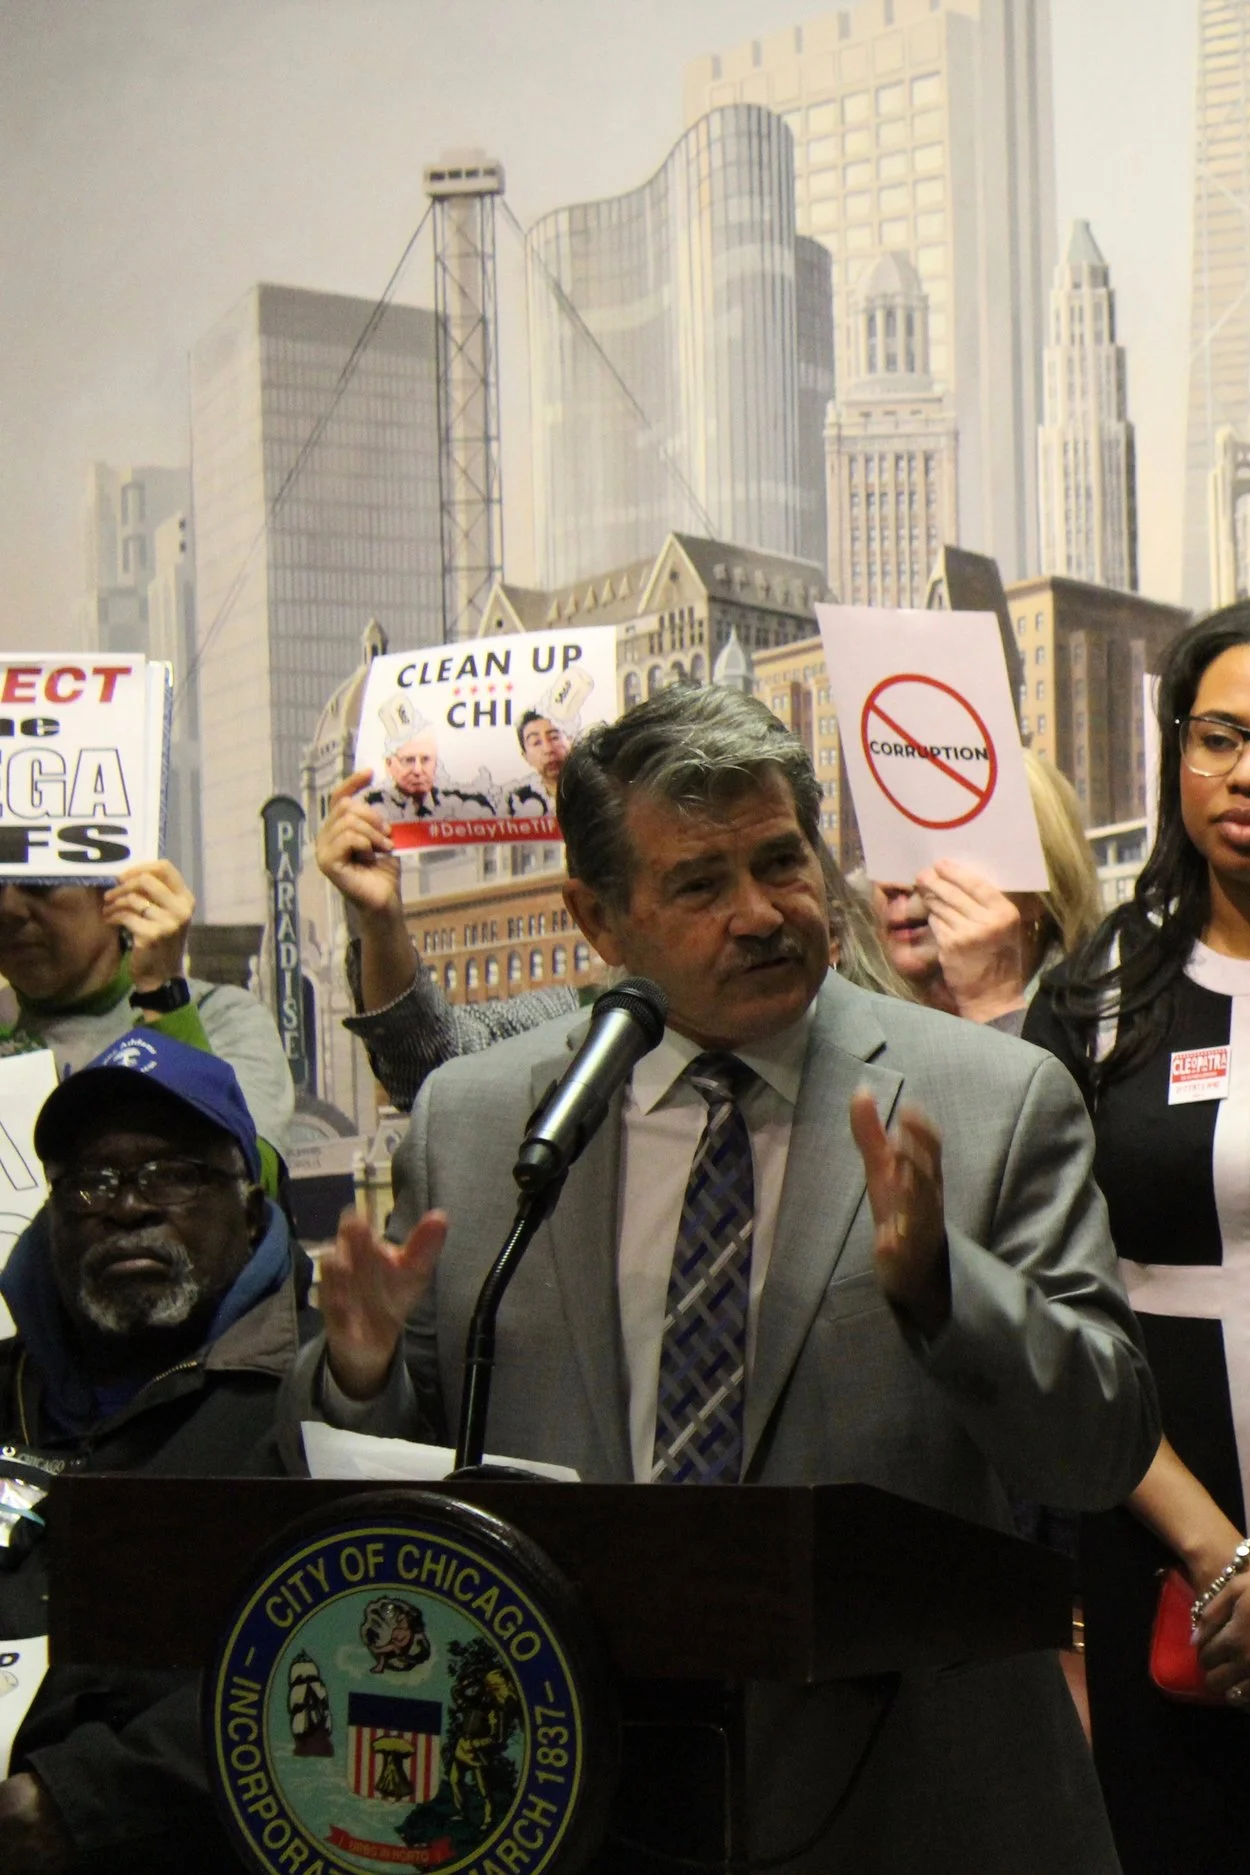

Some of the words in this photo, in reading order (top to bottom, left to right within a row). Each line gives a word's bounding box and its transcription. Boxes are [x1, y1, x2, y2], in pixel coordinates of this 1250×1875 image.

[396, 649, 513, 688] CLEAN
[531, 645, 582, 673] UP
[446, 698, 513, 729] CHI
[869, 740, 990, 761] CORRUPTION
[0, 747, 131, 820] GA
[428, 817, 556, 841] #DelayTheTIF
[276, 820, 299, 1062] PARADISE
[1172, 1053, 1227, 1075] CLEOPATRA
[264, 1556, 331, 1628] CITY
[339, 1542, 385, 1581] OF
[396, 1543, 543, 1663] CHICAGO
[226, 1675, 341, 1875] INCORPORA
[467, 1792, 558, 1875] ARCH
[534, 1704, 570, 1785] 1837
